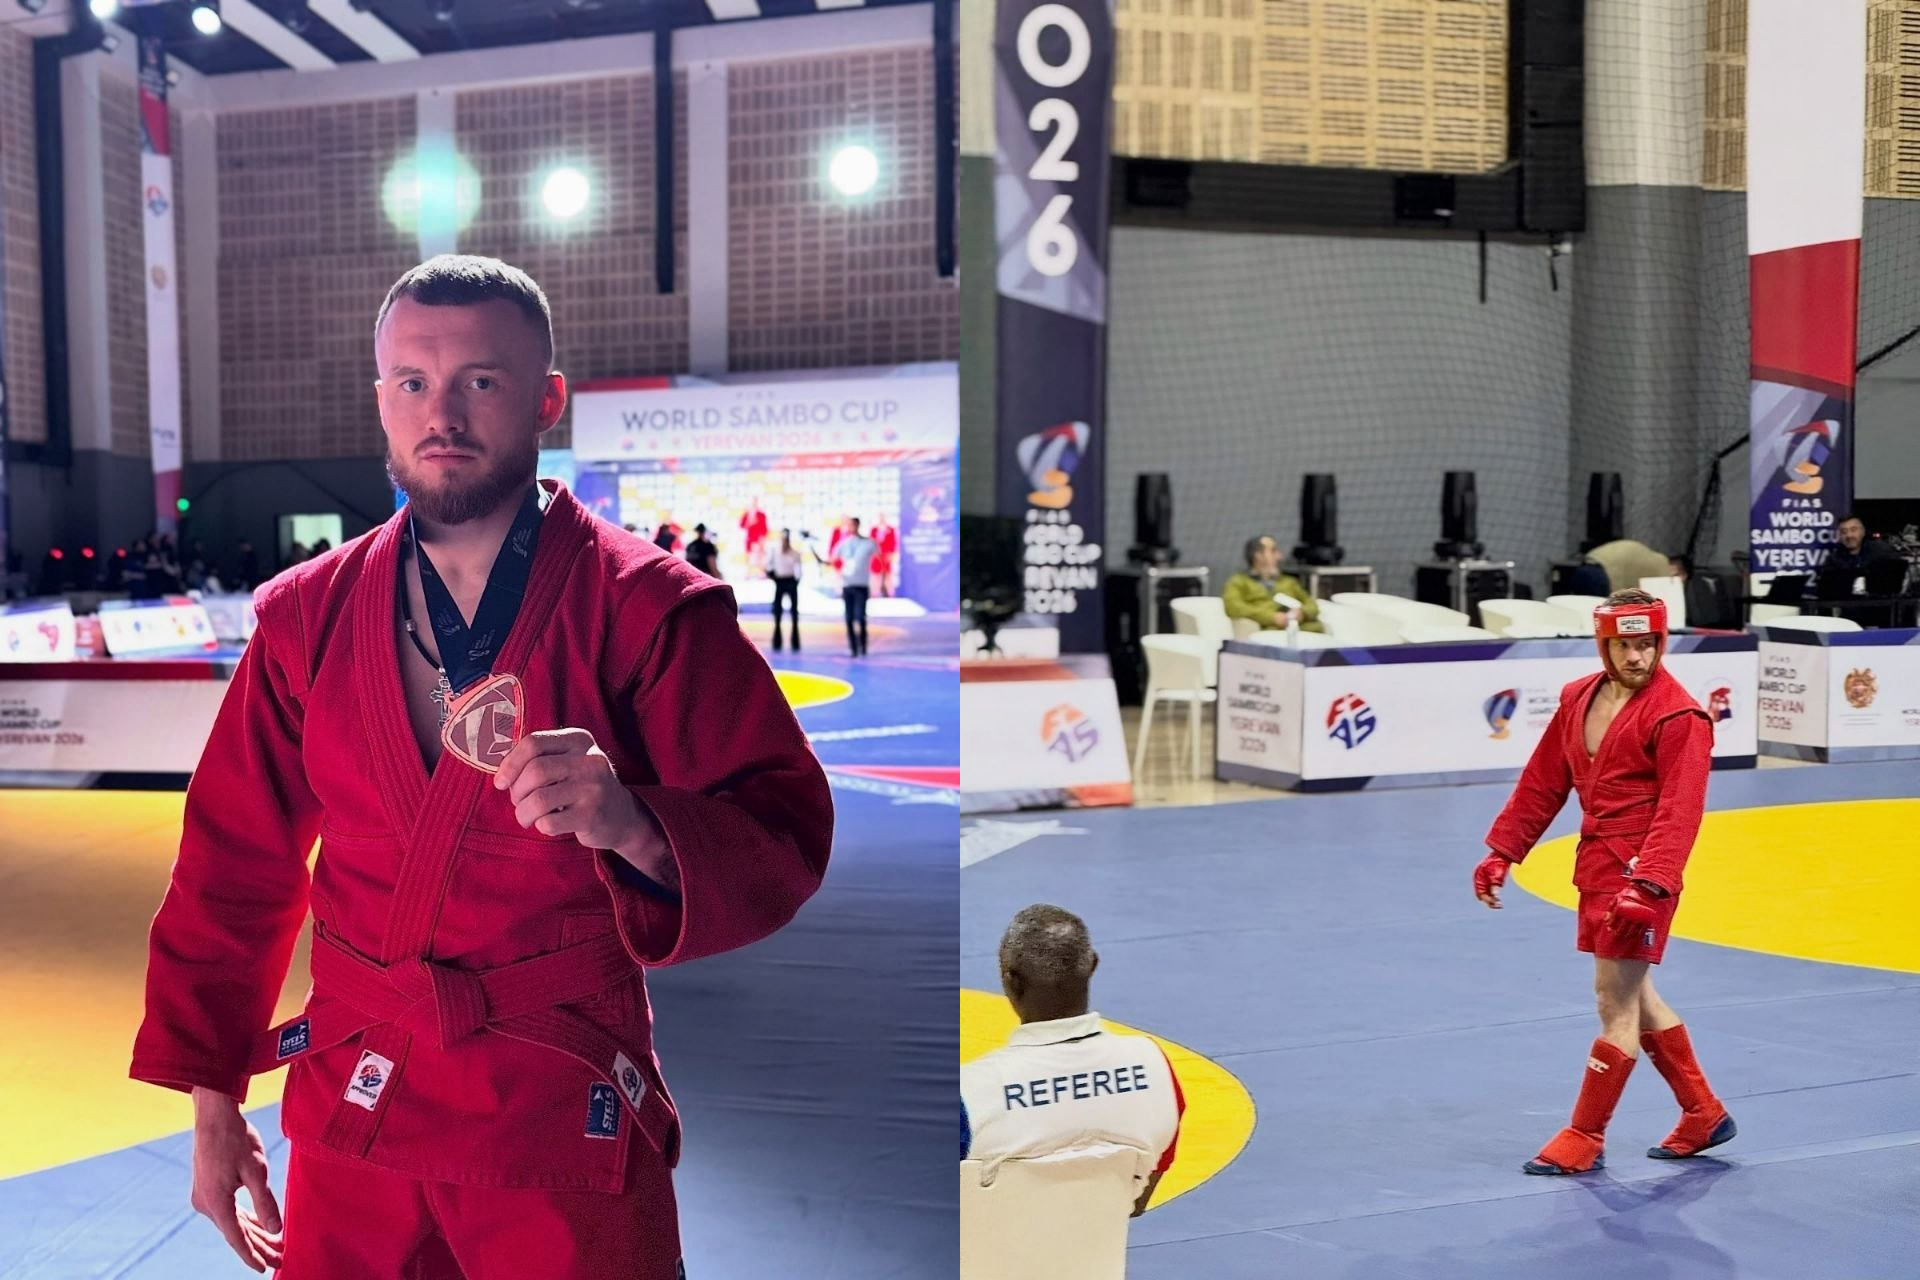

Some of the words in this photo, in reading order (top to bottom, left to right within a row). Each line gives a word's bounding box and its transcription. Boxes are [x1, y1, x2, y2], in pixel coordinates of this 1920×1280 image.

[622, 407, 721, 431] WORLD
[730, 402, 833, 428] SAMBO
[841, 399, 898, 422] CUP
[1781, 498, 1822, 508] FIAS
[1769, 512, 1834, 527] WORLD
[1750, 528, 1815, 545] SAMBO
[1817, 528, 1840, 544] CU
[1764, 666, 1797, 679] WORLD
[1239, 683, 1271, 698] WORLD
[1788, 683, 1806, 694] CUP
[1765, 715, 1792, 730] 2026
[1003, 1065, 1149, 1111] REFEREE
[602, 1090, 615, 1131] STELS
